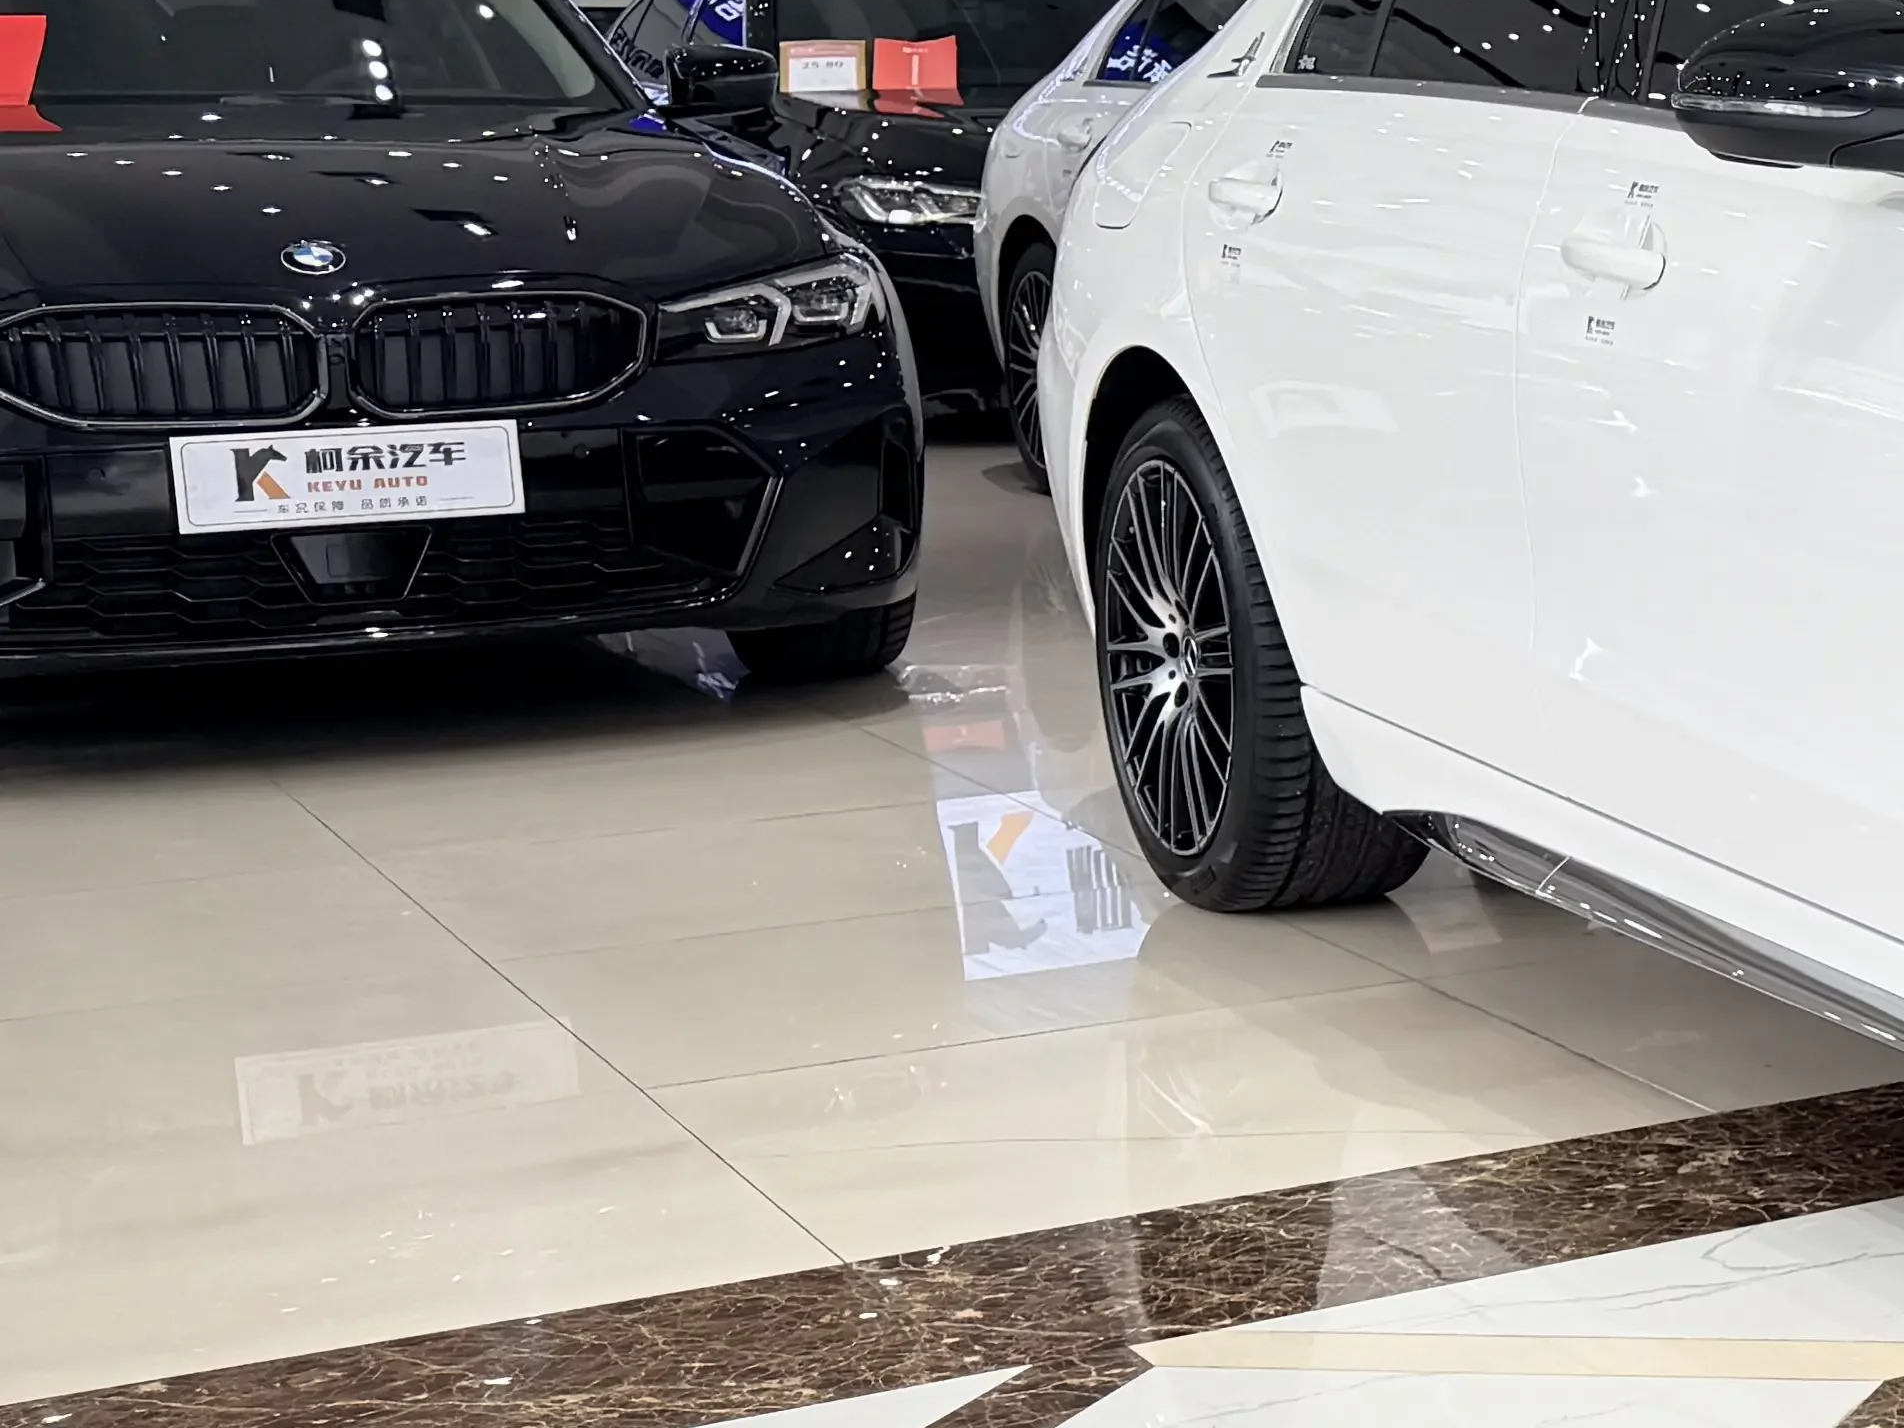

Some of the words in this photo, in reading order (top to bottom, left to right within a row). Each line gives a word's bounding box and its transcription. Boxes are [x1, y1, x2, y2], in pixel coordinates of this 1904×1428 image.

[304, 441, 466, 474] 柯余汽车
[307, 478, 362, 493] KEYU
[373, 475, 428, 490] AUTO
